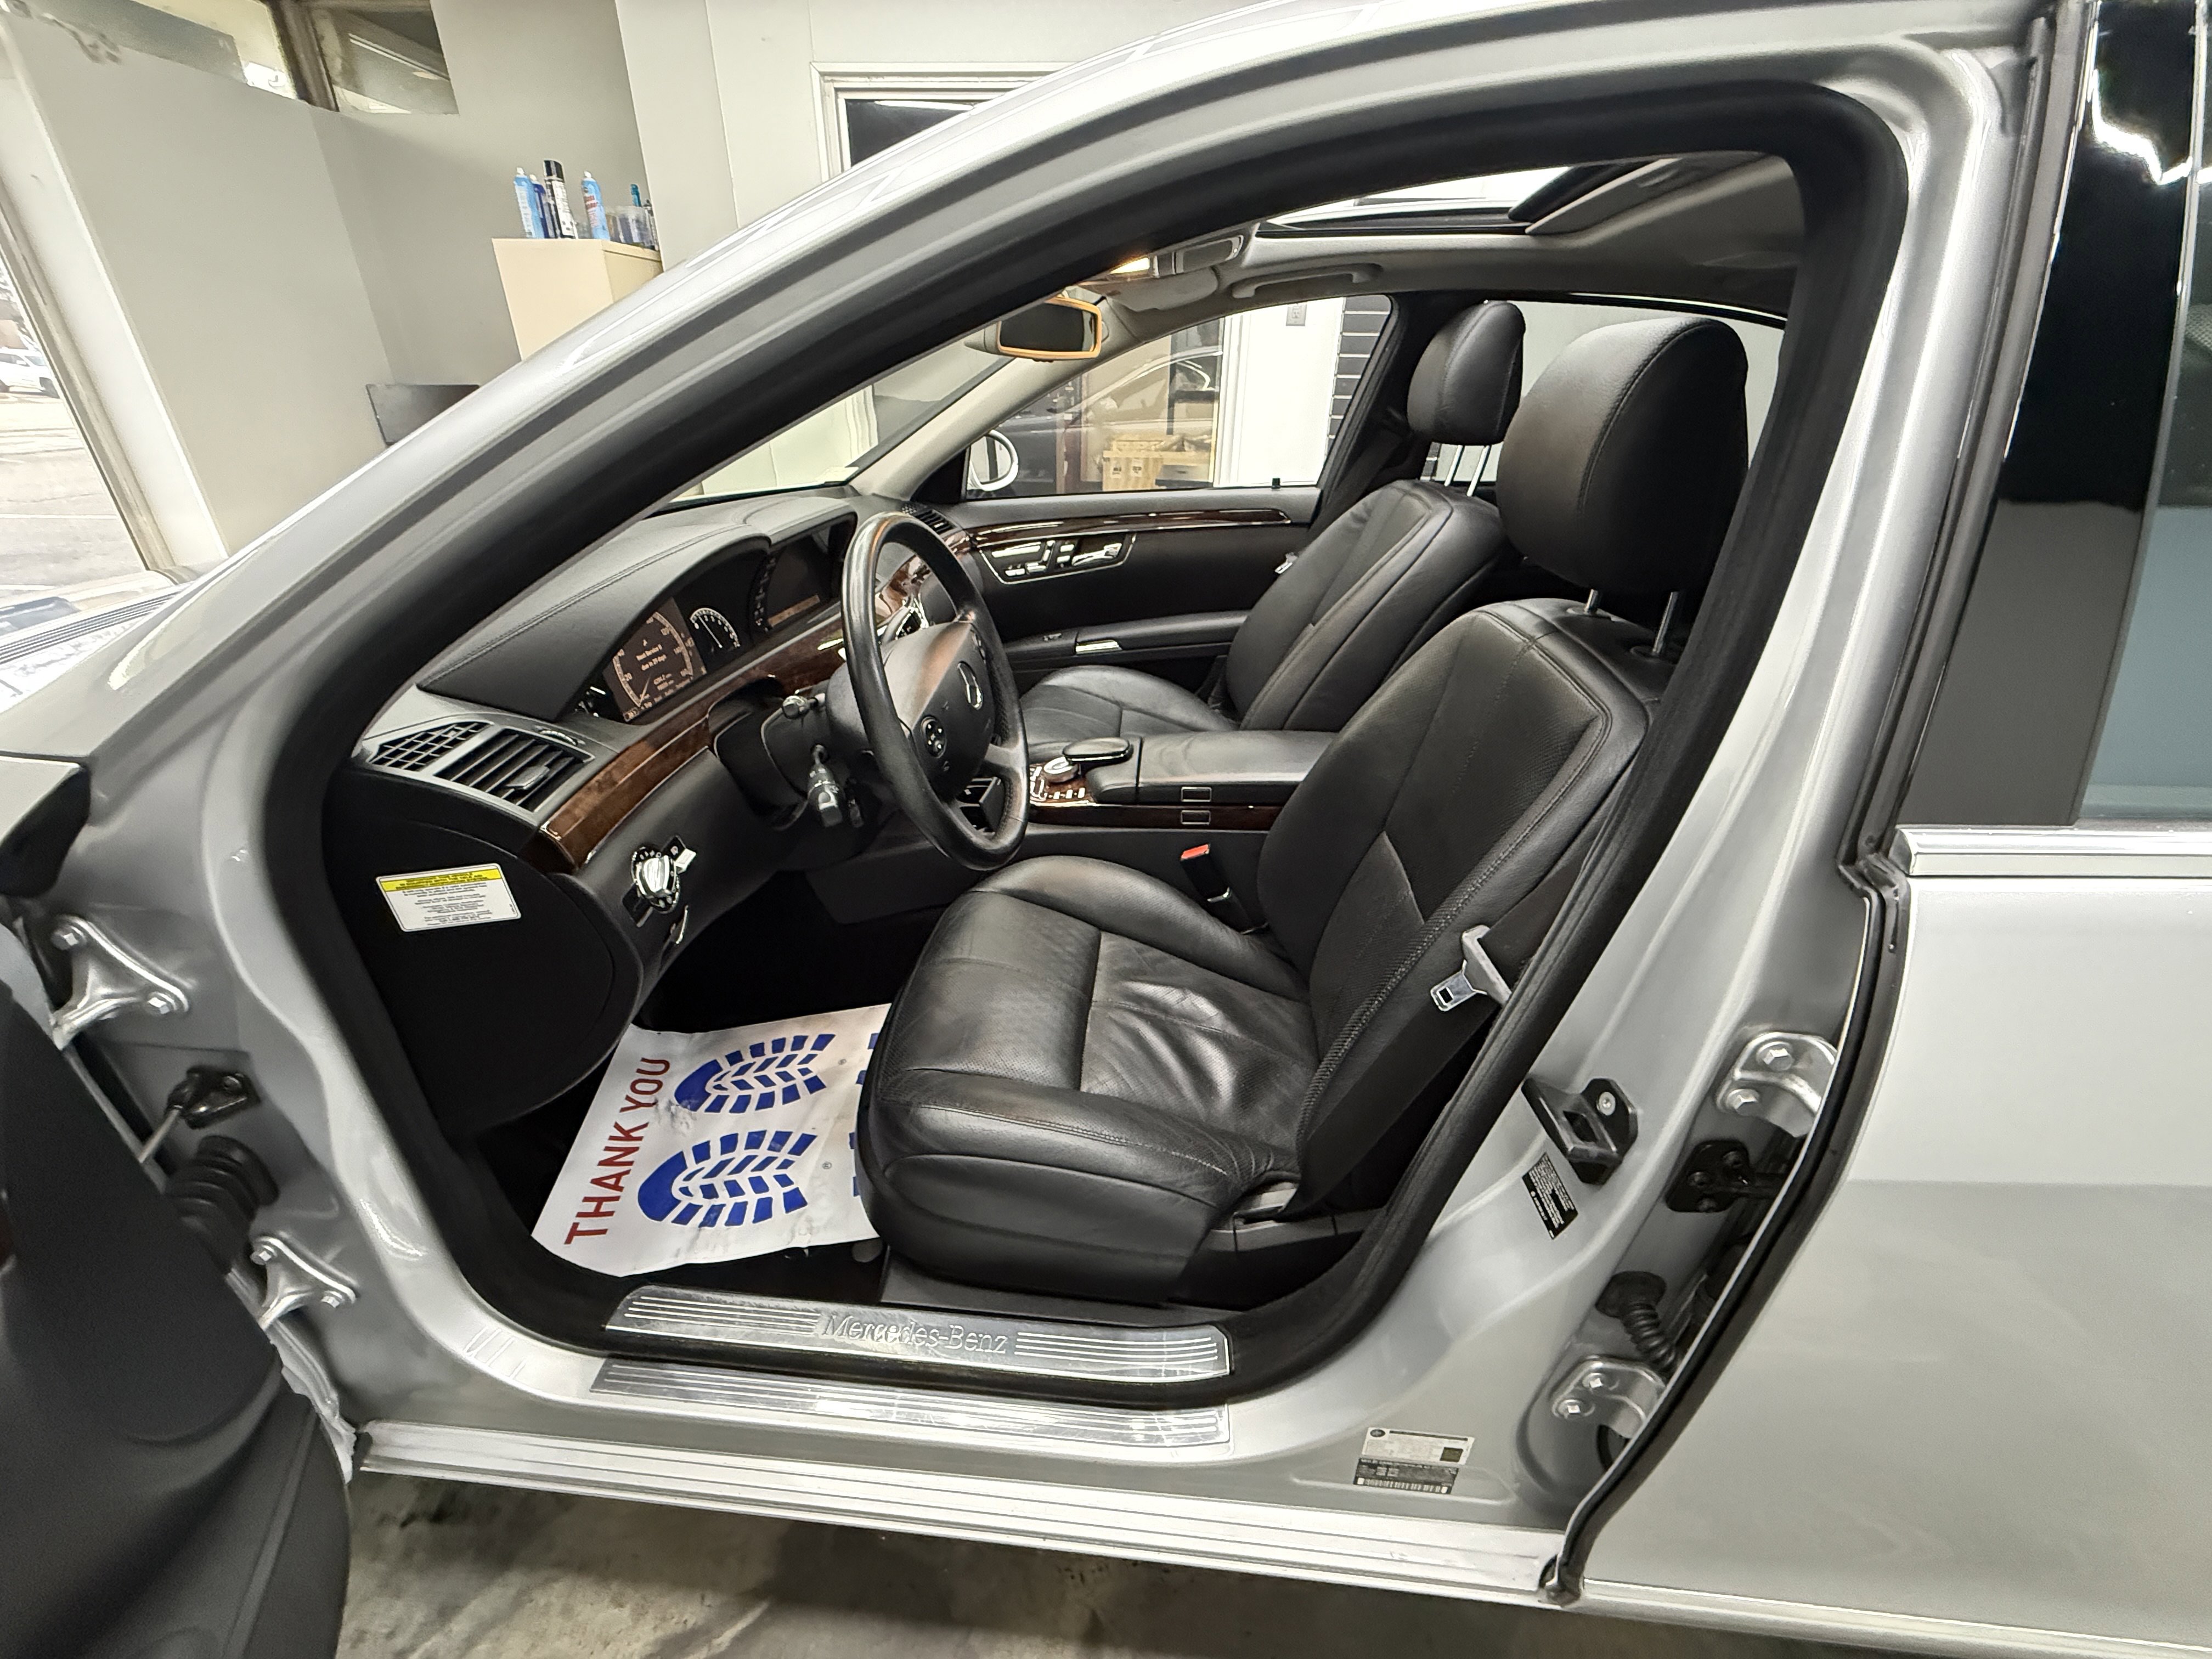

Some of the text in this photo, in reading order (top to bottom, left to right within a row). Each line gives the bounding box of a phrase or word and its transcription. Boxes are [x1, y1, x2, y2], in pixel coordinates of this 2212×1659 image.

[564, 1057, 670, 1245] THANK YOU
[823, 1315, 1008, 1354] Mercedes-Benz
